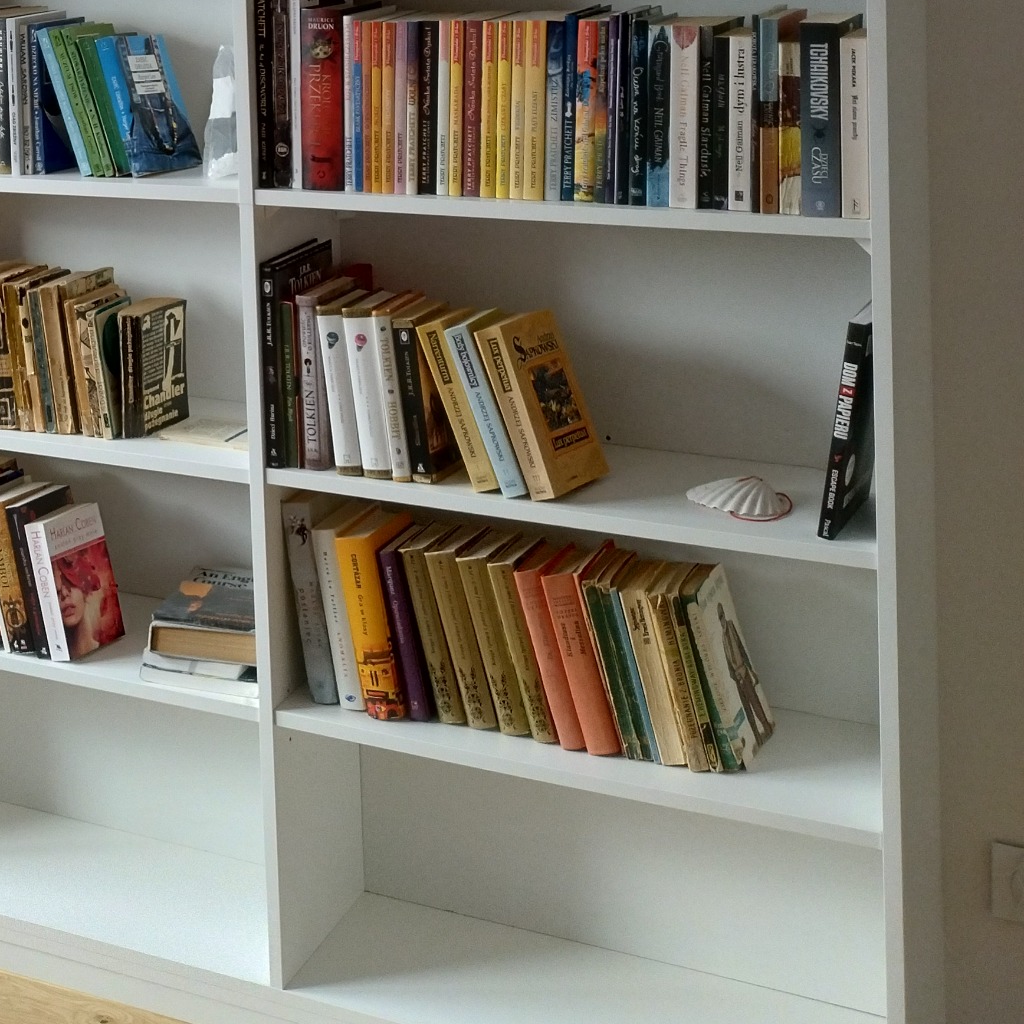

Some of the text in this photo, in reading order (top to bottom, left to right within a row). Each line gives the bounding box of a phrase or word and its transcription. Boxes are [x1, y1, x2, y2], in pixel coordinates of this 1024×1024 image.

[423, 85, 432, 115] Nauka
[550, 79, 558, 122] ZIMISTRZ
[809, 43, 829, 121] TCHAIKOVSKY
[468, 90, 476, 120] Nauka
[654, 108, 664, 163] NEIL GAIMAN
[811, 147, 822, 184] CZASU
[289, 268, 322, 292] TOLKIEN
[512, 336, 558, 366] SAPKOWSKI
[144, 383, 185, 410] Chandler
[381, 337, 400, 440] TOLKIEN HOBBIT
[428, 332, 476, 458] Narrenturm ANDRZEJ SAPKOWSKI
[453, 334, 464, 352] Boży
[475, 391, 490, 422] ANDRZEJ
[485, 421, 505, 462] SAPKOWSKI
[491, 338, 536, 468] Lux perpetua ANDRZEJ SAPKOWSKI
[834, 362, 858, 440] DOM Z PAPIERU
[304, 389, 316, 445] TOLKIEN
[554, 439, 563, 450] Lux
[827, 469, 839, 510] ESCAPE BOOK
[30, 530, 49, 598] HARLAN COBEN
[350, 553, 362, 589] CORTÁZAR
